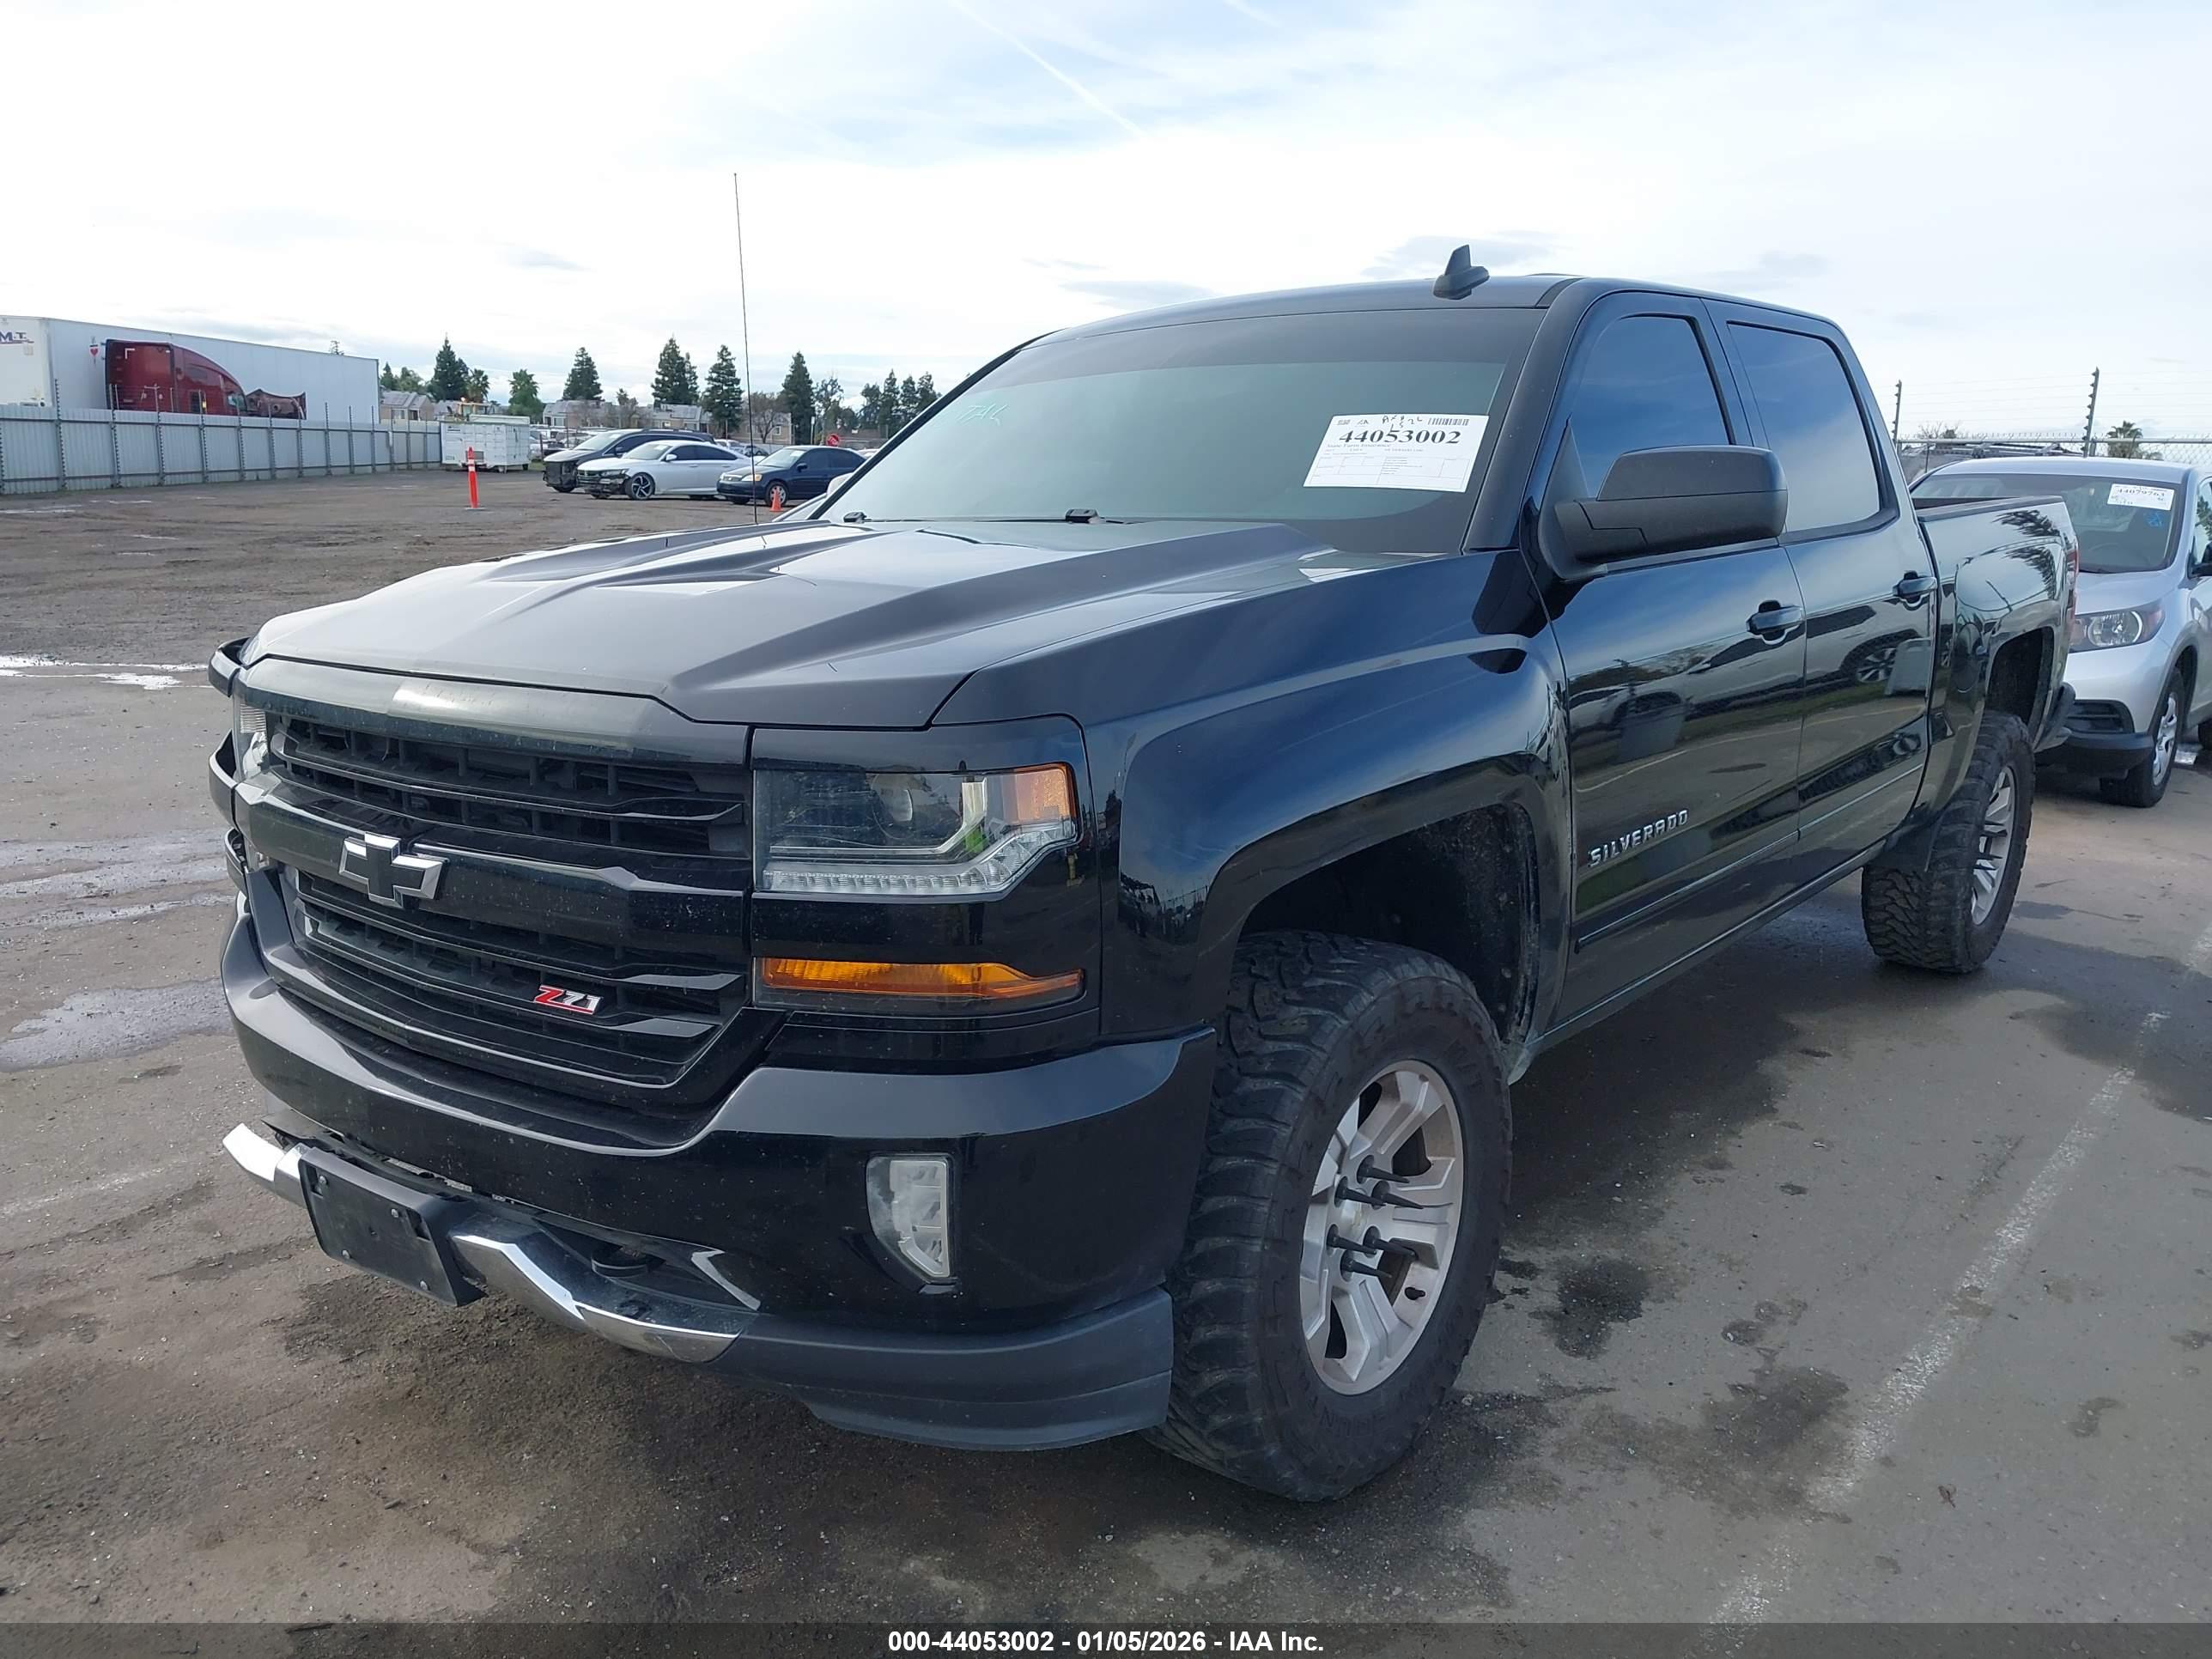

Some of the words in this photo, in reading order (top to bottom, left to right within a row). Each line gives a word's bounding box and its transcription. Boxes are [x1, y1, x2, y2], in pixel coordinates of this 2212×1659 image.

[1339, 429, 1462, 444] 44053002
[1587, 809, 1689, 867] SILVERADO
[534, 985, 602, 1015] Z71
